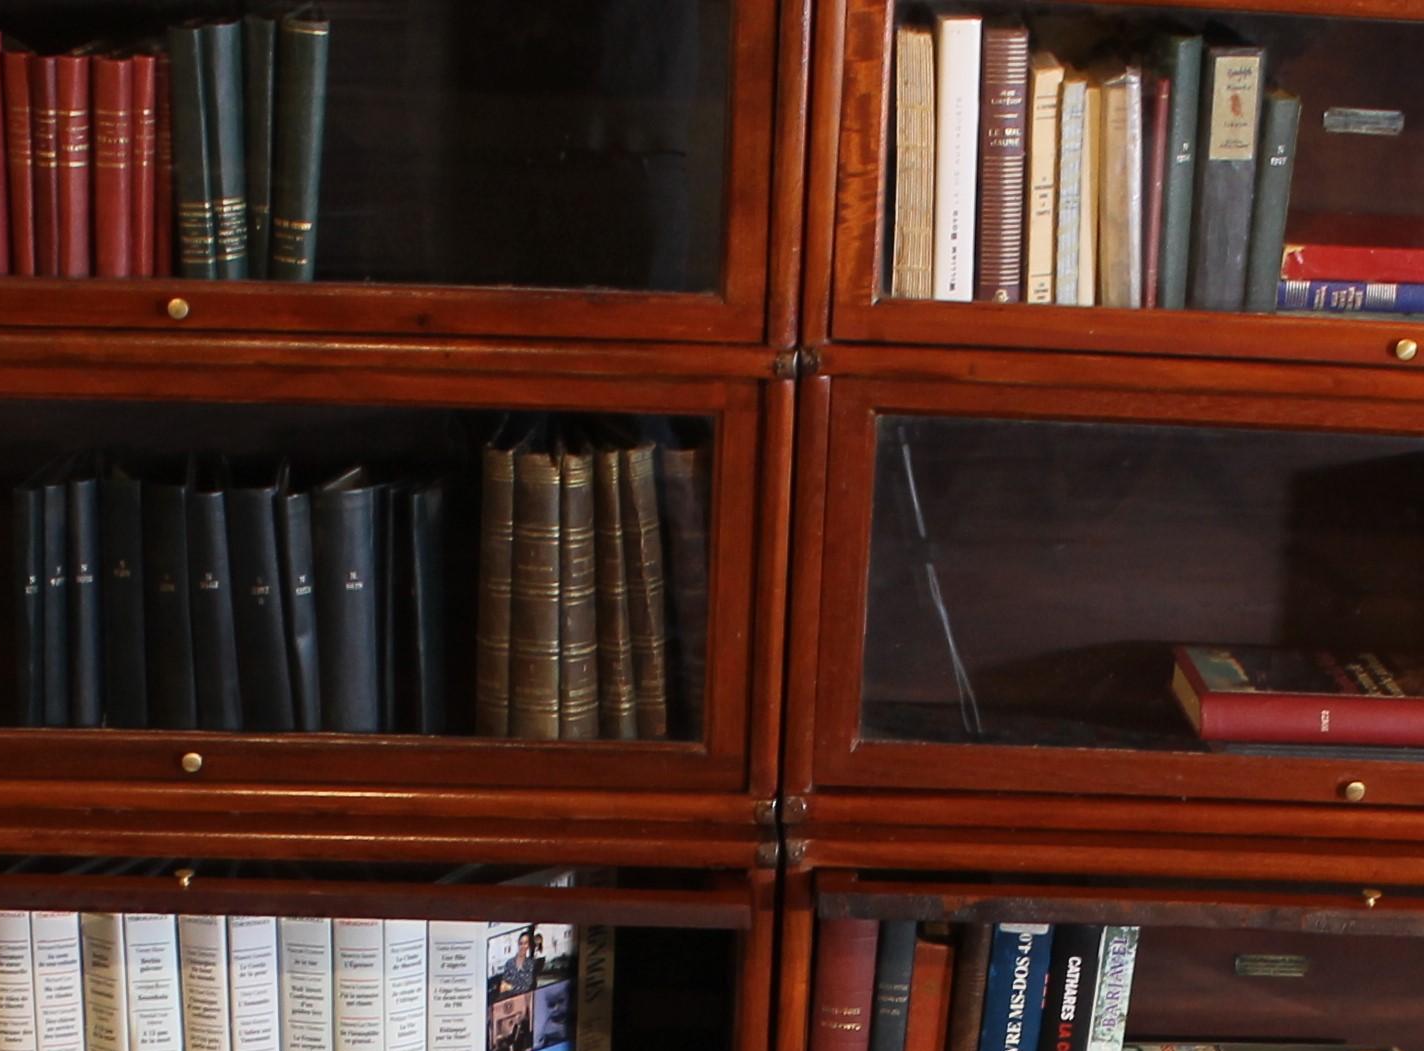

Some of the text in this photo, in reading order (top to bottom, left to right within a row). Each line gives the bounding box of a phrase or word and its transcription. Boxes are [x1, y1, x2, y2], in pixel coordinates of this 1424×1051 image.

[1017, 933, 1033, 955] 4.0
[1008, 956, 1031, 1020] MS-DOS
[1060, 956, 1082, 1021] CATHARES
[1101, 936, 1128, 1030] BARJAVEL
[1058, 1023, 1073, 1039] LA
